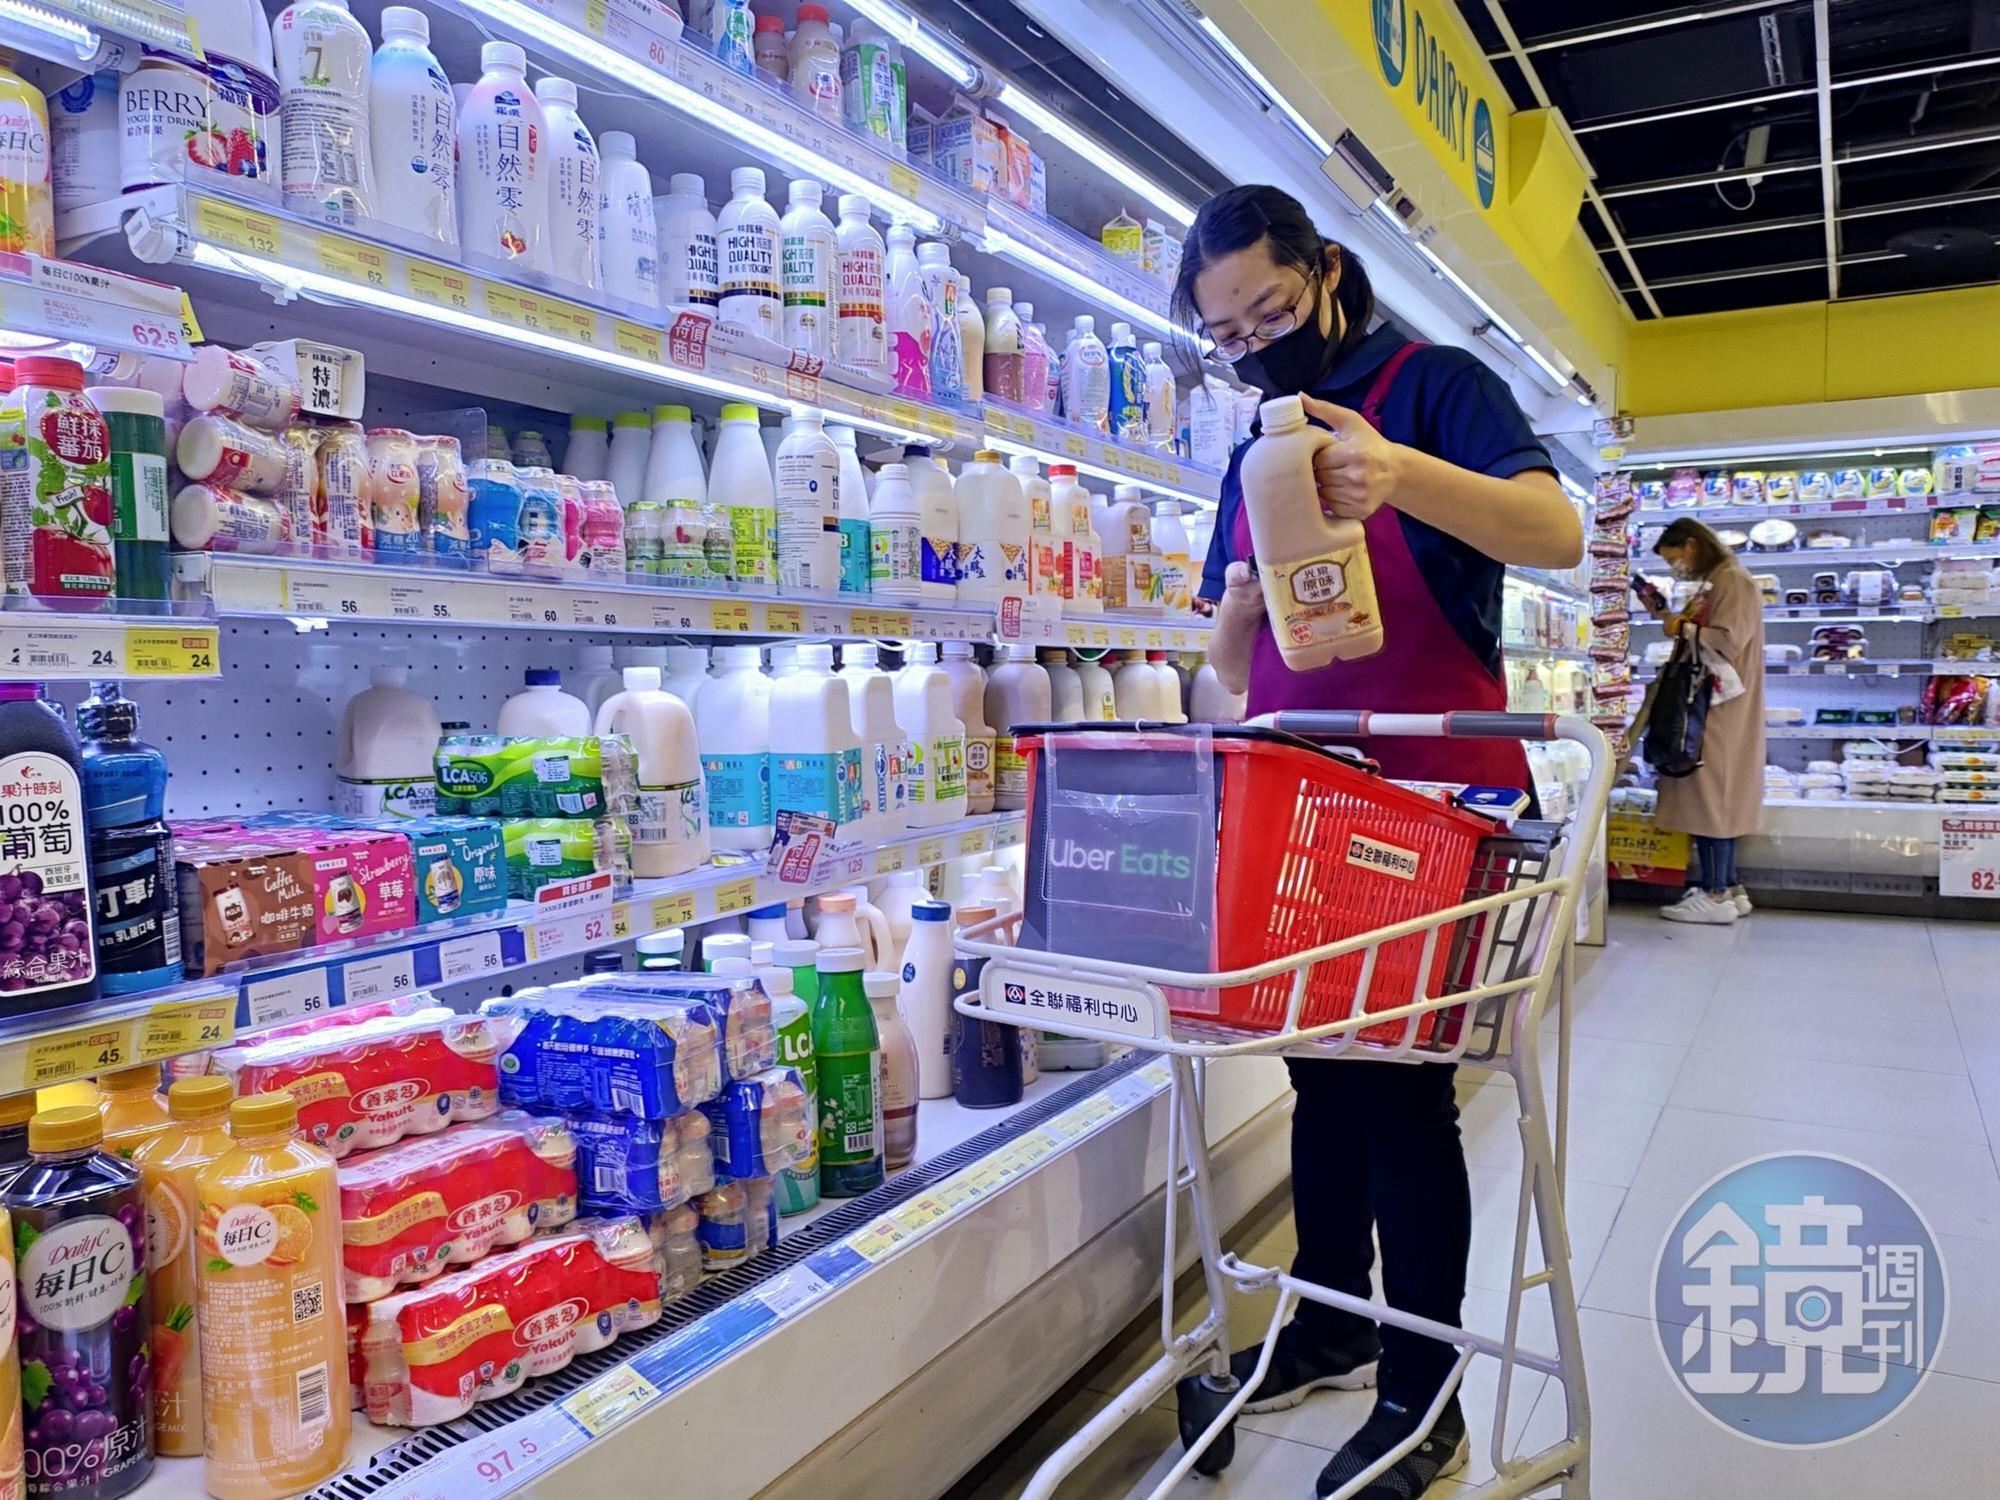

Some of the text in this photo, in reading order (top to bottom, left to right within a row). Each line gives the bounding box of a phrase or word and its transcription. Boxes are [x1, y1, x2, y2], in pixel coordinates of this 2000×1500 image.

[649, 43, 665, 65] 80
[1415, 9, 1468, 163] DAIRY
[126, 89, 213, 118] BERRY
[126, 114, 204, 128] YOGURT DRINK
[496, 121, 523, 216] 自然零
[248, 236, 275, 253] 132
[728, 236, 755, 250] HIGH
[728, 250, 772, 265] QUALITY
[783, 249, 797, 261] IGH
[688, 258, 718, 275] QUALIT
[783, 261, 814, 274] UALITY
[843, 262, 868, 274] HIGH
[367, 270, 383, 284] 62
[843, 273, 882, 286] QUALITY
[451, 295, 466, 308] 62
[180, 322, 192, 337] 5
[525, 314, 539, 328] 62
[132, 324, 178, 347] 62.5
[580, 331, 592, 343] 62
[752, 366, 768, 385] 59
[312, 365, 332, 410] 特濃
[57, 416, 102, 437] 鮮採
[1303, 575, 1335, 592] 原味
[341, 600, 358, 614] 56
[433, 604, 448, 617] 55
[544, 610, 558, 622] 60
[605, 613, 617, 626] 60
[680, 617, 691, 629] 60
[91, 649, 113, 665] 24
[191, 654, 211, 668] 24
[441, 767, 489, 785] LCA506
[1, 780, 62, 798] 果汁時刻
[0, 799, 70, 826] 100%
[1, 822, 73, 861] 葡萄
[461, 834, 500, 863] Original
[1050, 837, 1191, 879] Uber Eats
[1363, 846, 1417, 874] 全聯福利中心
[359, 853, 412, 886] Strawberry
[473, 865, 497, 884] 原味
[264, 865, 295, 894] Coffee
[278, 886, 305, 904] Milk
[378, 880, 405, 900] 草莓
[742, 895, 752, 906] 75
[260, 904, 314, 926] 咖啡牛奶
[682, 910, 692, 921] 75
[585, 920, 602, 941] 52
[614, 923, 626, 935] 54
[3, 949, 87, 980] 綜合果汁
[484, 953, 498, 967] 56
[394, 974, 409, 989] 56
[304, 995, 321, 1011] 56
[1030, 989, 1138, 1023] 全聯福利中心
[201, 1025, 220, 1040] 24
[98, 1048, 121, 1064] 45
[368, 1104, 416, 1124] Yakult
[223, 1220, 272, 1247] 每日C
[464, 1218, 508, 1241] Yakult
[35, 1241, 125, 1299] 每日C
[530, 1329, 577, 1355] Yakult
[629, 1386, 650, 1402] 74
[476, 1437, 538, 1484] 97.5
